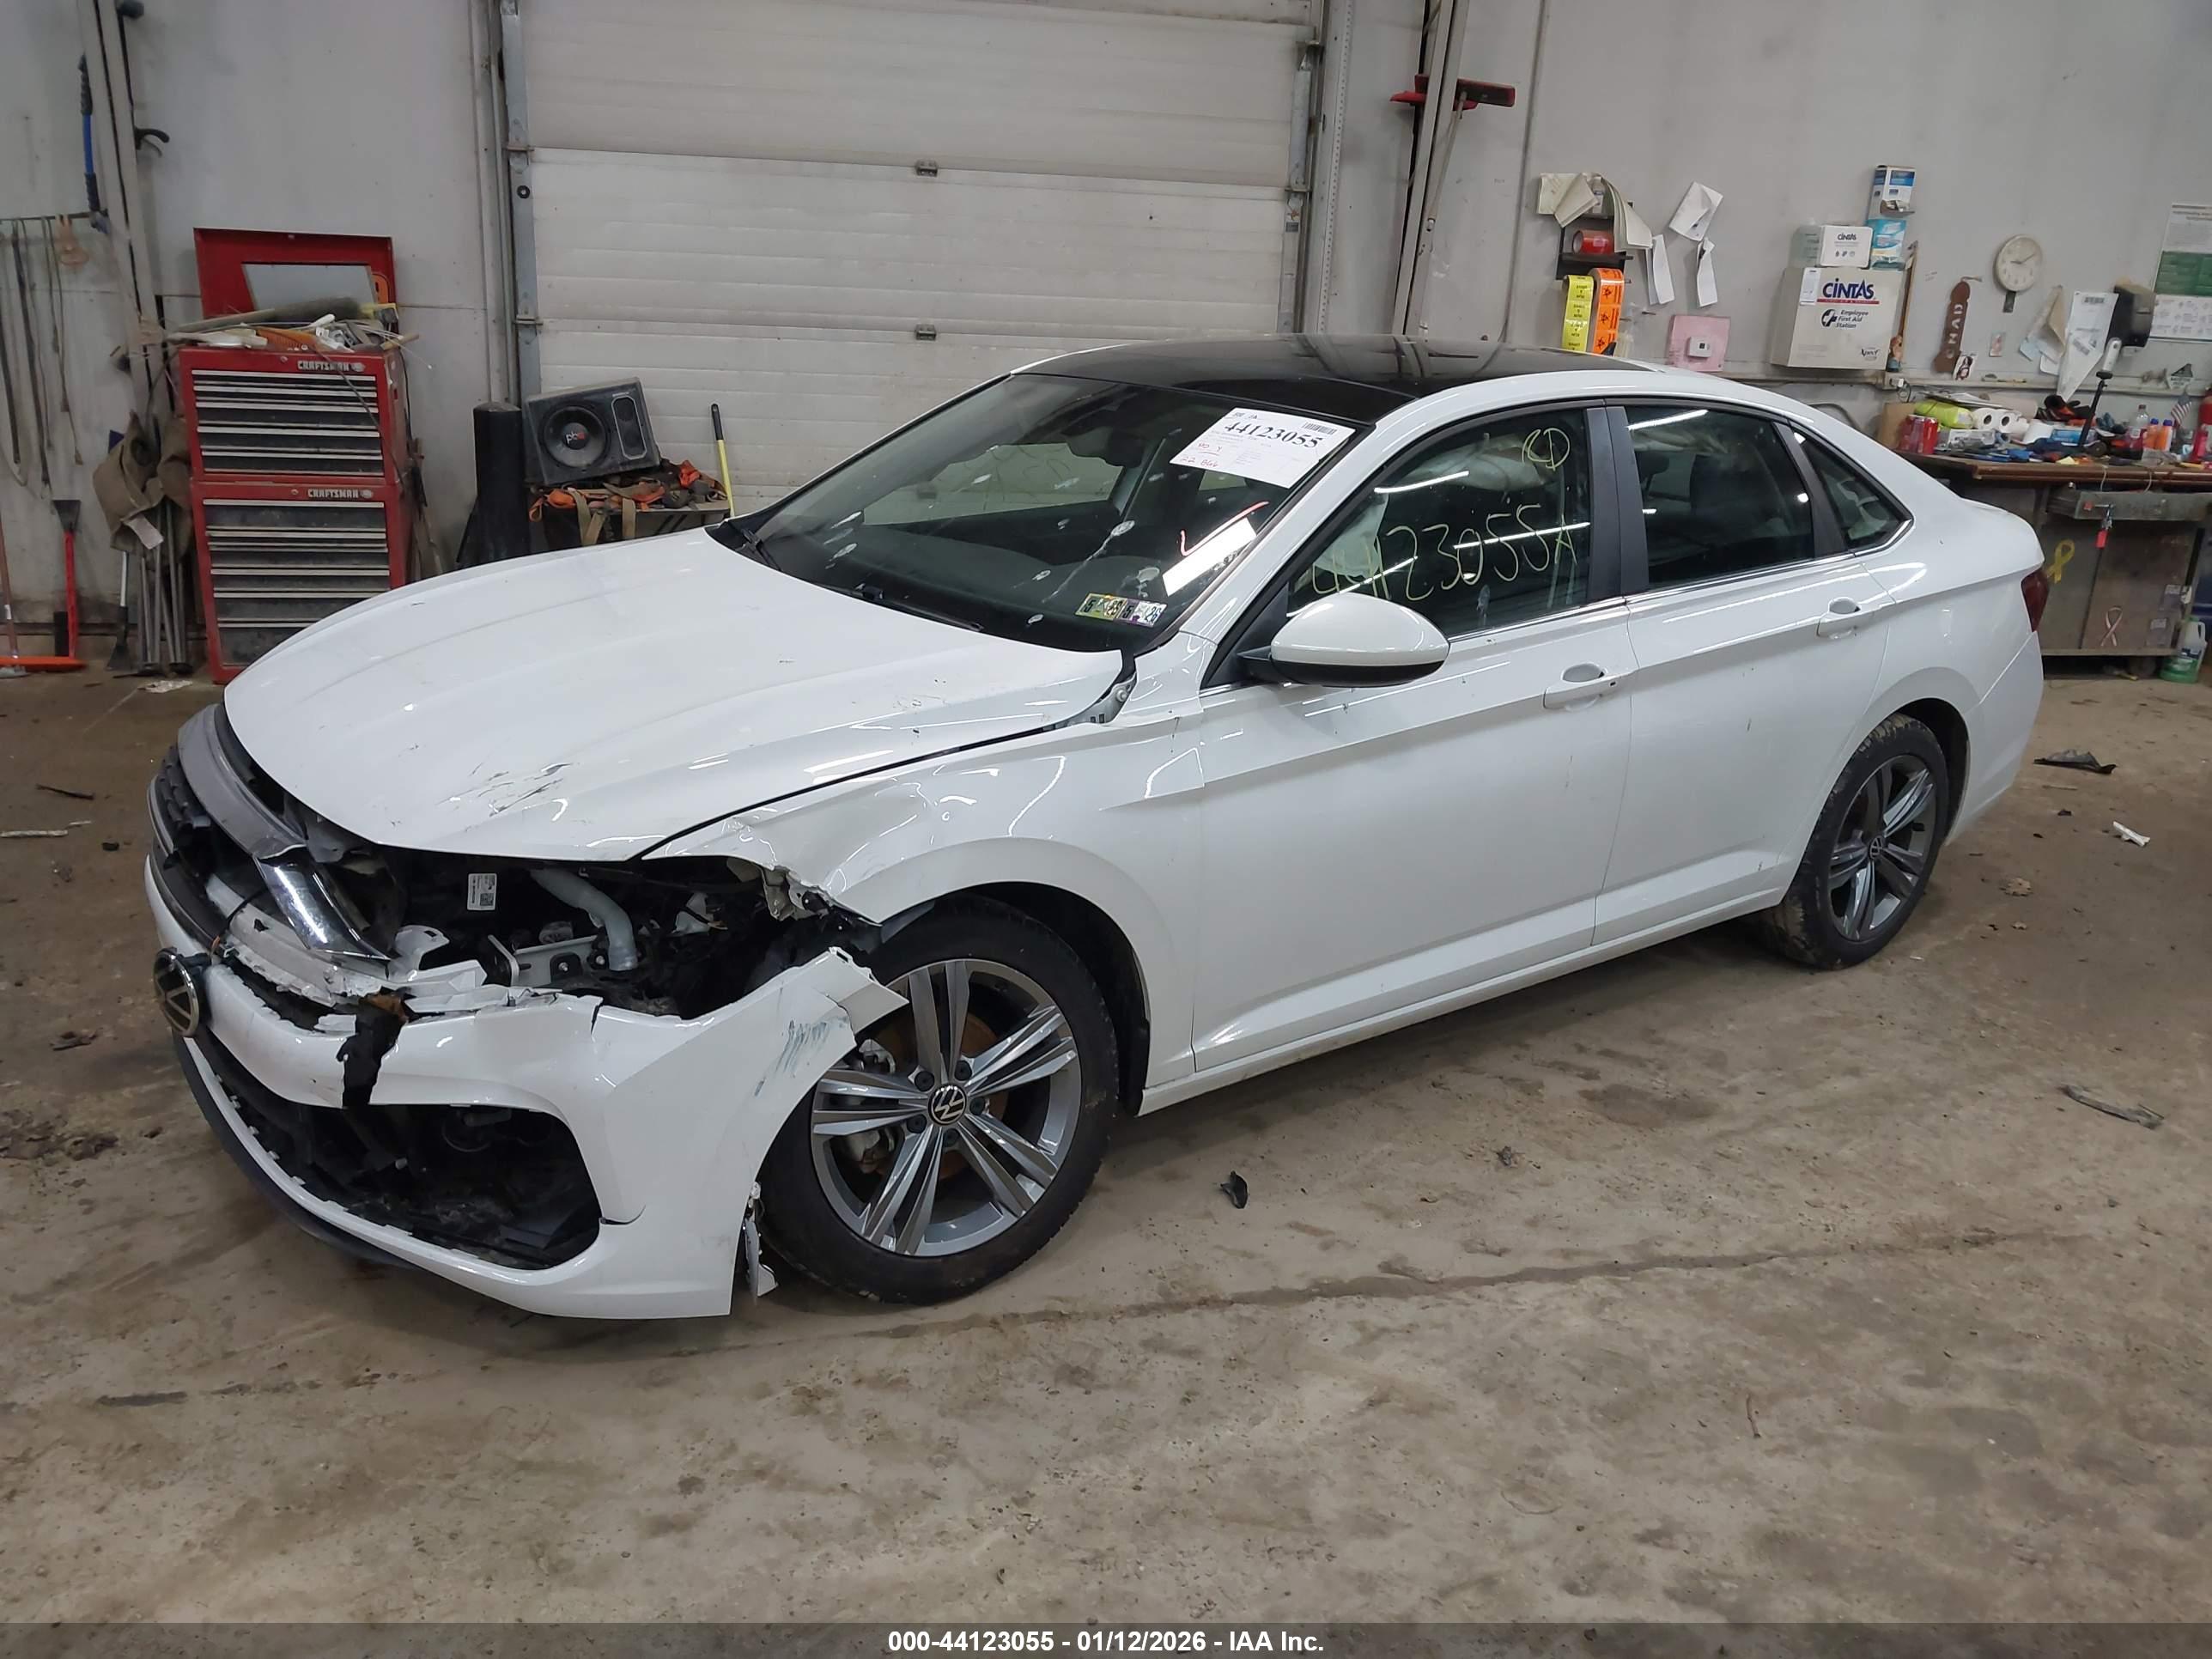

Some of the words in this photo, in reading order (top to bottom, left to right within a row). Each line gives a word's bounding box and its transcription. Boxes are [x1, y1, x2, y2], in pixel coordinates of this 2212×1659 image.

[1822, 277, 1875, 300] CINTAS
[1224, 422, 1323, 448] 44123055
[307, 488, 358, 498] CRAFTSMAN
